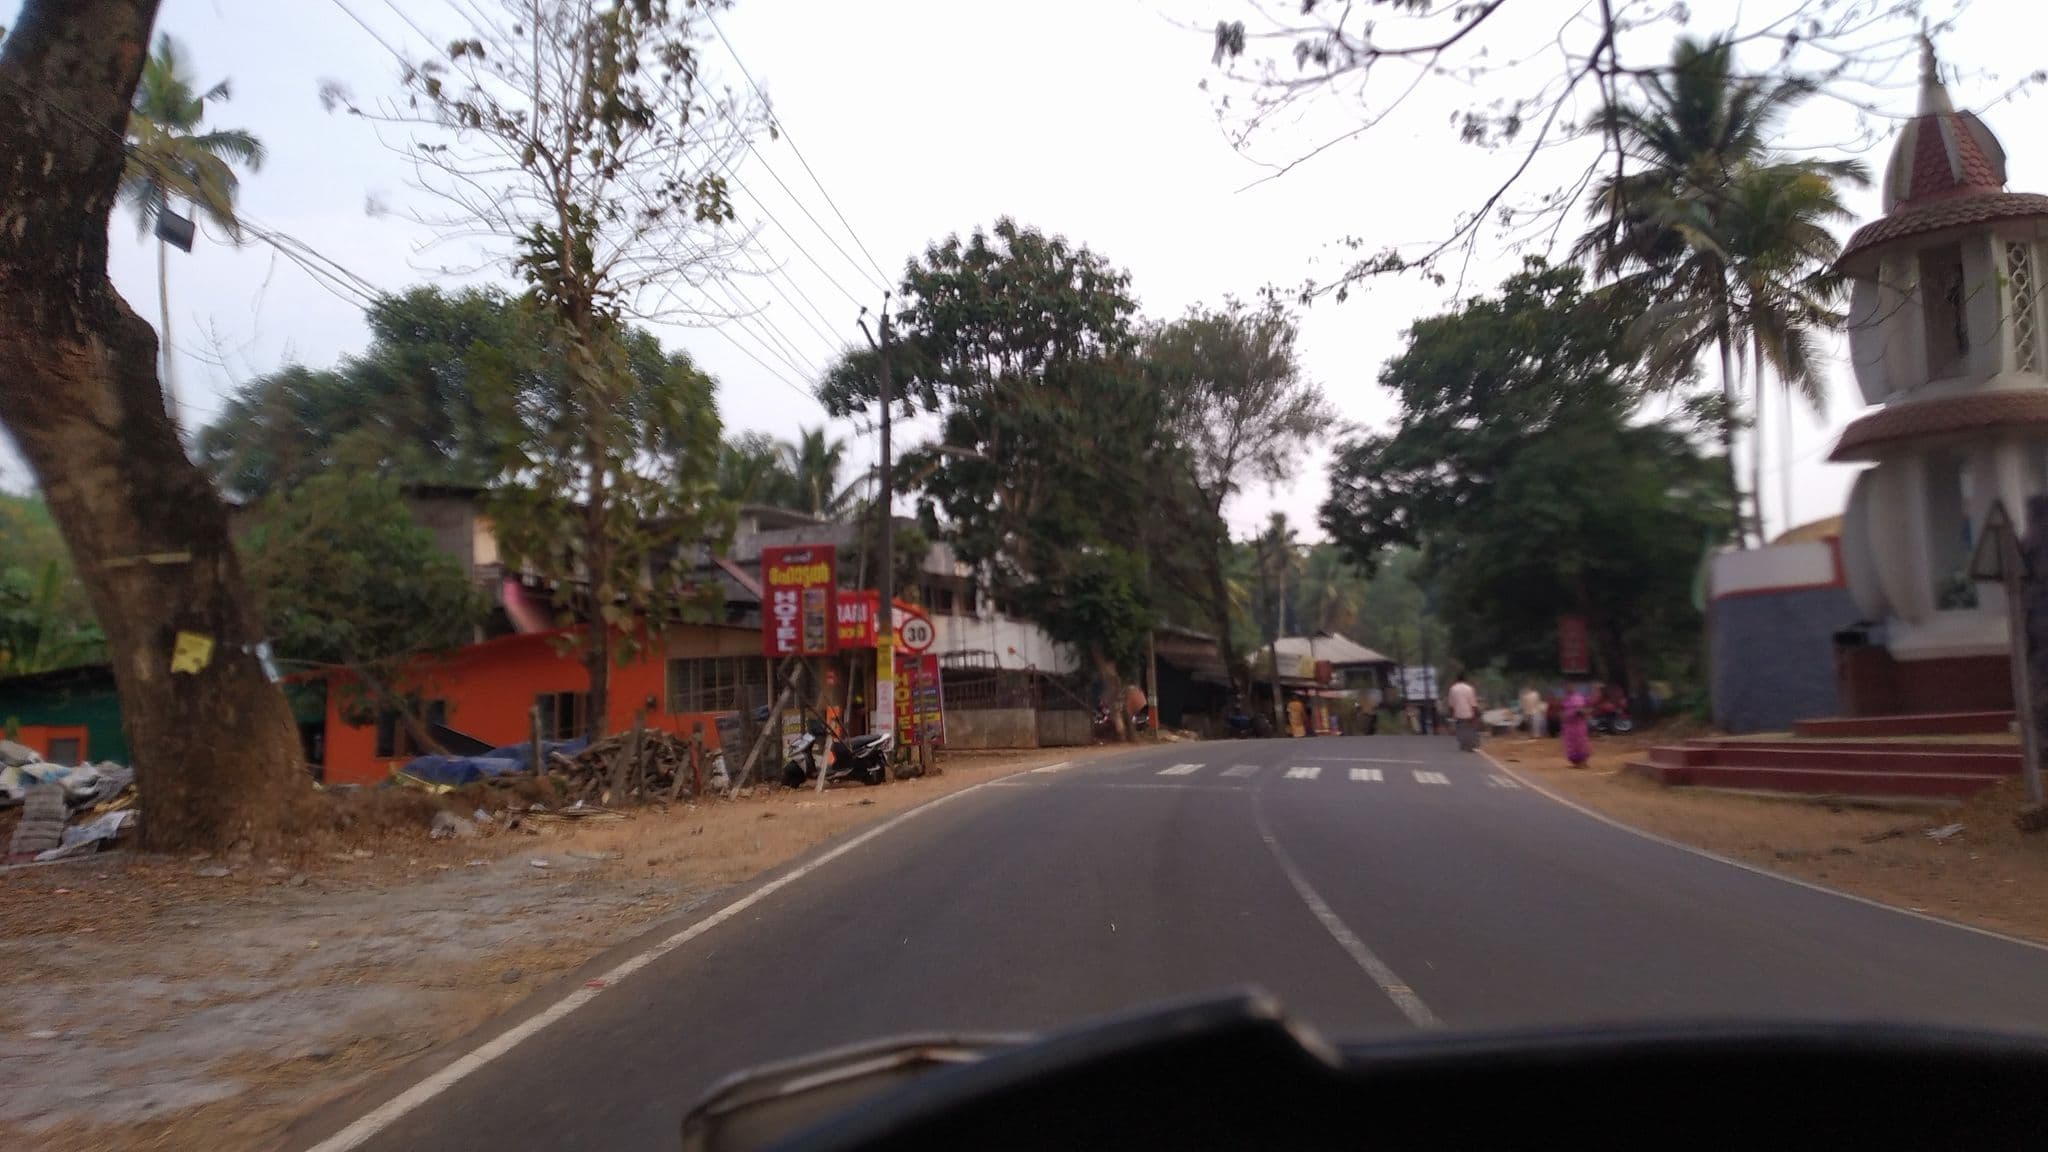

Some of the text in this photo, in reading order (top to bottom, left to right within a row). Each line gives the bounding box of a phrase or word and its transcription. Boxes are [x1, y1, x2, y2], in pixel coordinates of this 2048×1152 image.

[773, 591, 798, 651] HOTEL
[907, 626, 927, 642] 30
[895, 672, 912, 744] HOTEL
